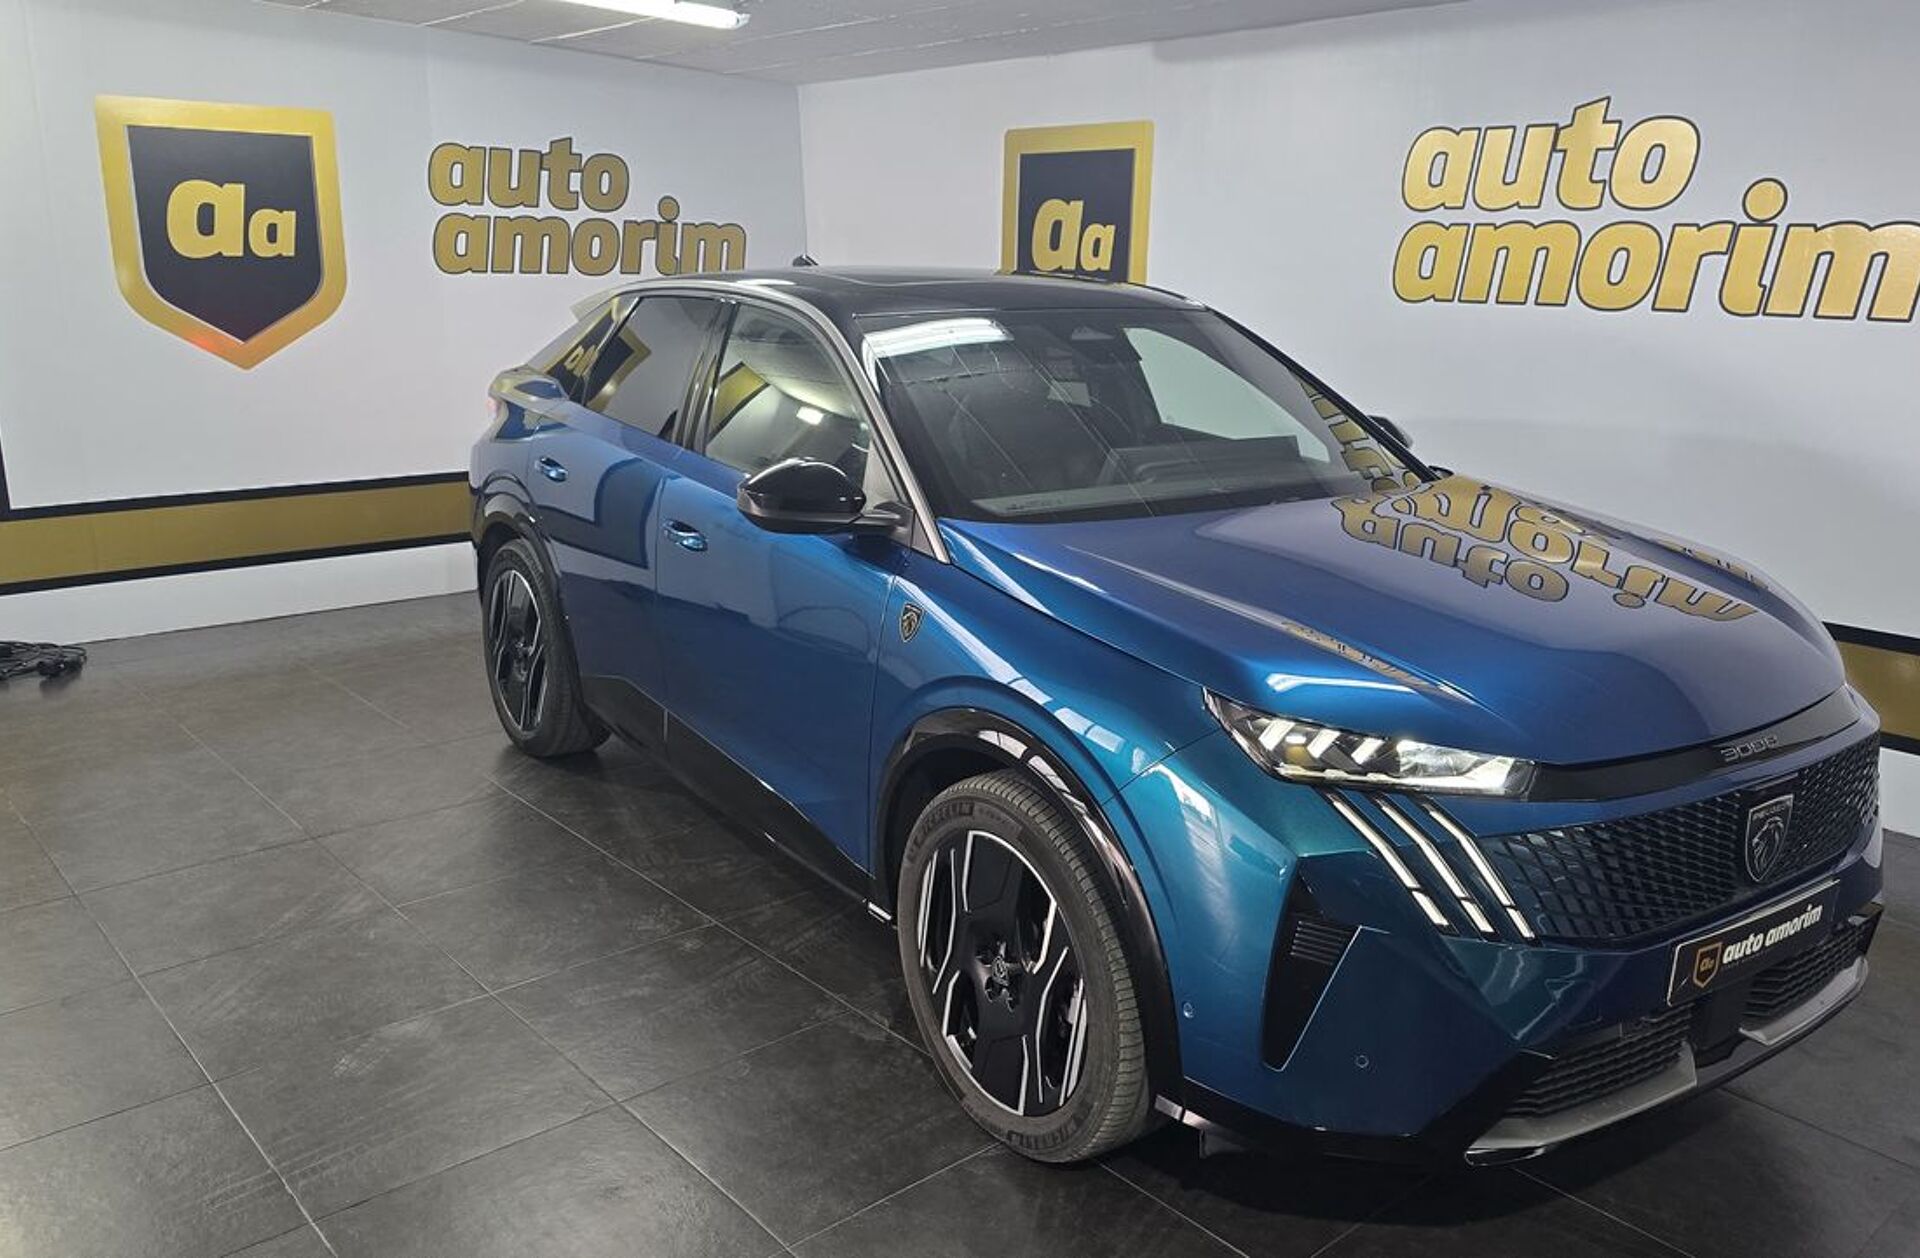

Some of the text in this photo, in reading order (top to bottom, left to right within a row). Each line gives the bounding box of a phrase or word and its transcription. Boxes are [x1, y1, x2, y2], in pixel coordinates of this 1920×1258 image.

[428, 137, 629, 212] auto
[1402, 96, 1700, 211] auto
[433, 196, 747, 276] amorim
[1393, 178, 1920, 322] amorim
[1722, 932, 1764, 964] auto
[1765, 904, 1823, 947] amorim
